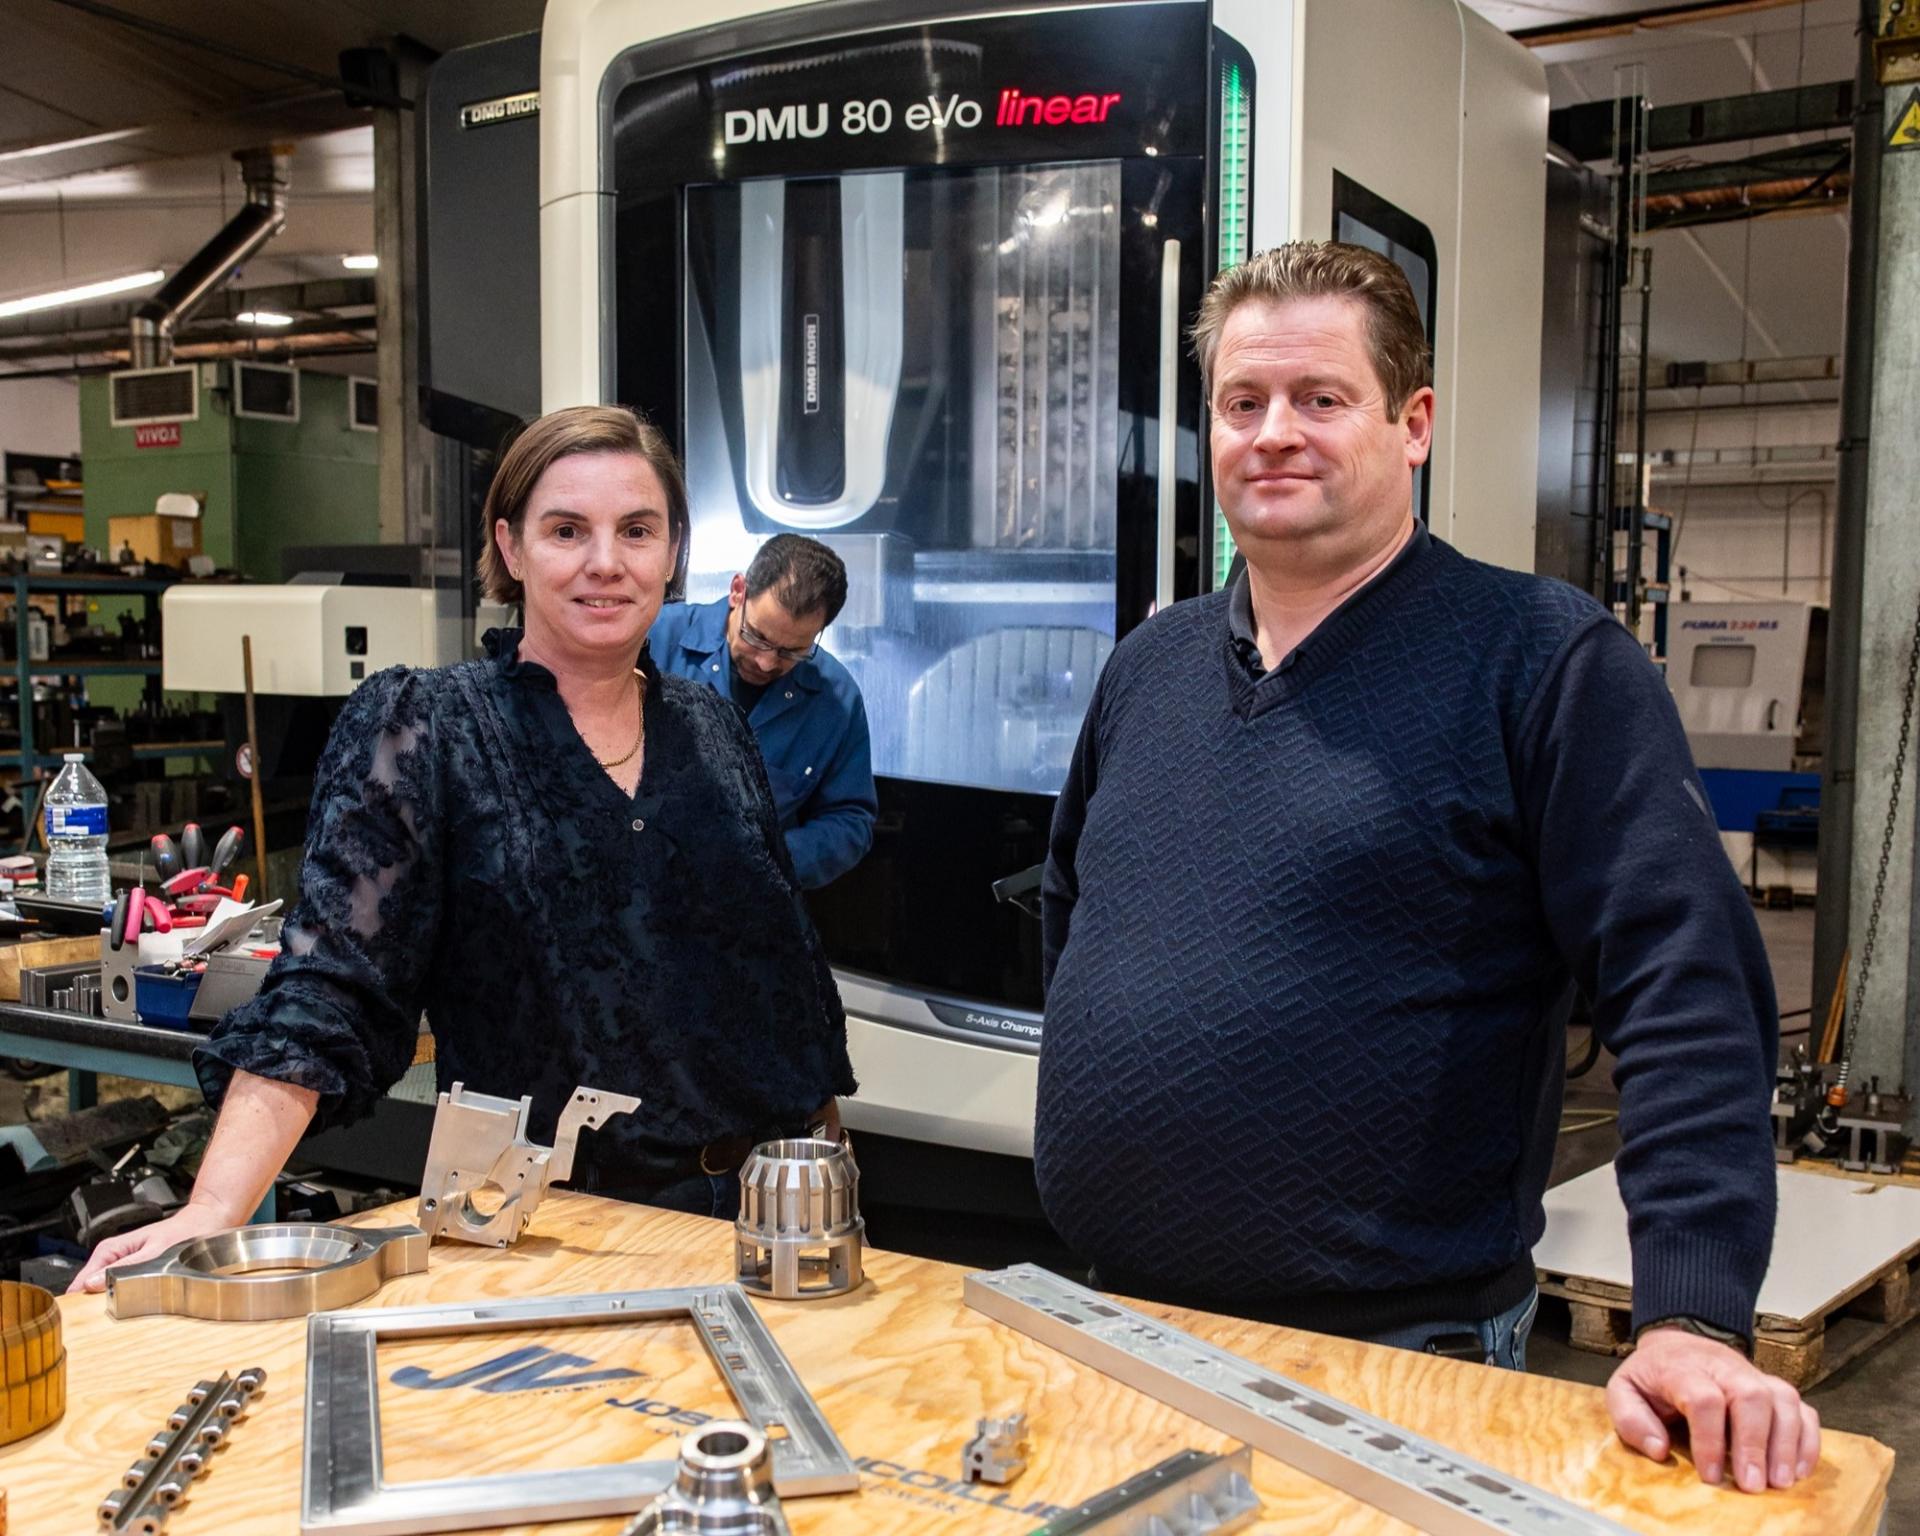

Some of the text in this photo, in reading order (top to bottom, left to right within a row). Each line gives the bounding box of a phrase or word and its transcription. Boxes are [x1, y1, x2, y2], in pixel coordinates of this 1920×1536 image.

[470, 98, 540, 123] DMG MOR
[725, 109, 829, 145] DMU
[841, 98, 893, 135] 80
[996, 89, 1121, 127] linear
[807, 324, 817, 403] DMG MORI
[965, 1014, 1043, 1036] 5-Axis Champi
